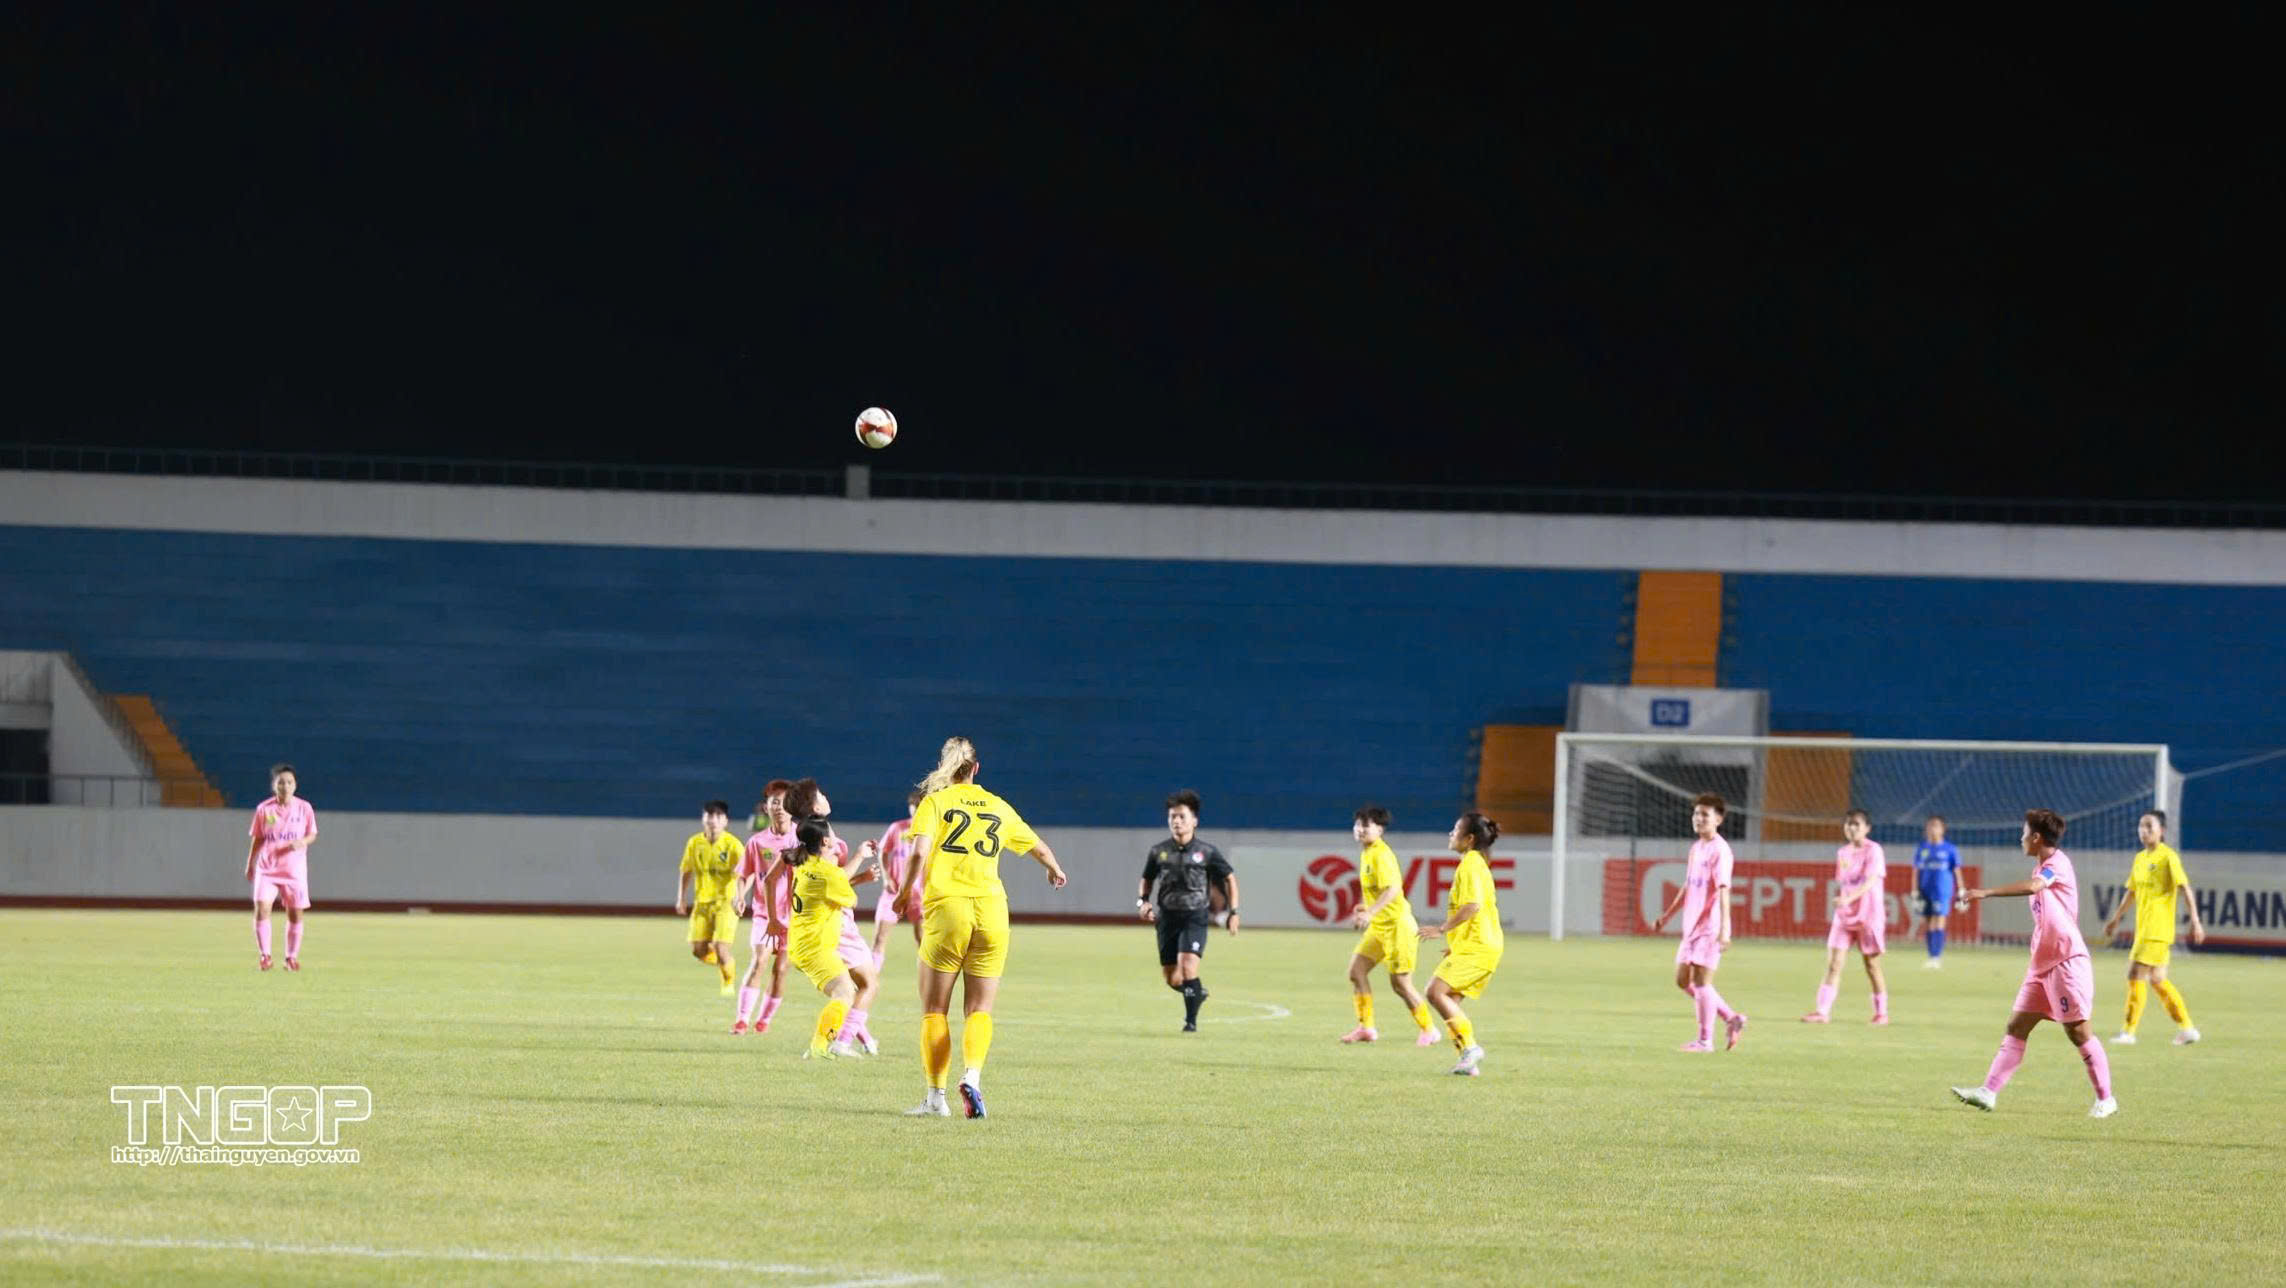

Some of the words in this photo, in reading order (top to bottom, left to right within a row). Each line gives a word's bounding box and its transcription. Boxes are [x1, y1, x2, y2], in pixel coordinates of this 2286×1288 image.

[960, 799, 986, 807] LAKE
[941, 809, 1002, 857] 23
[2059, 997, 2069, 1013] 9
